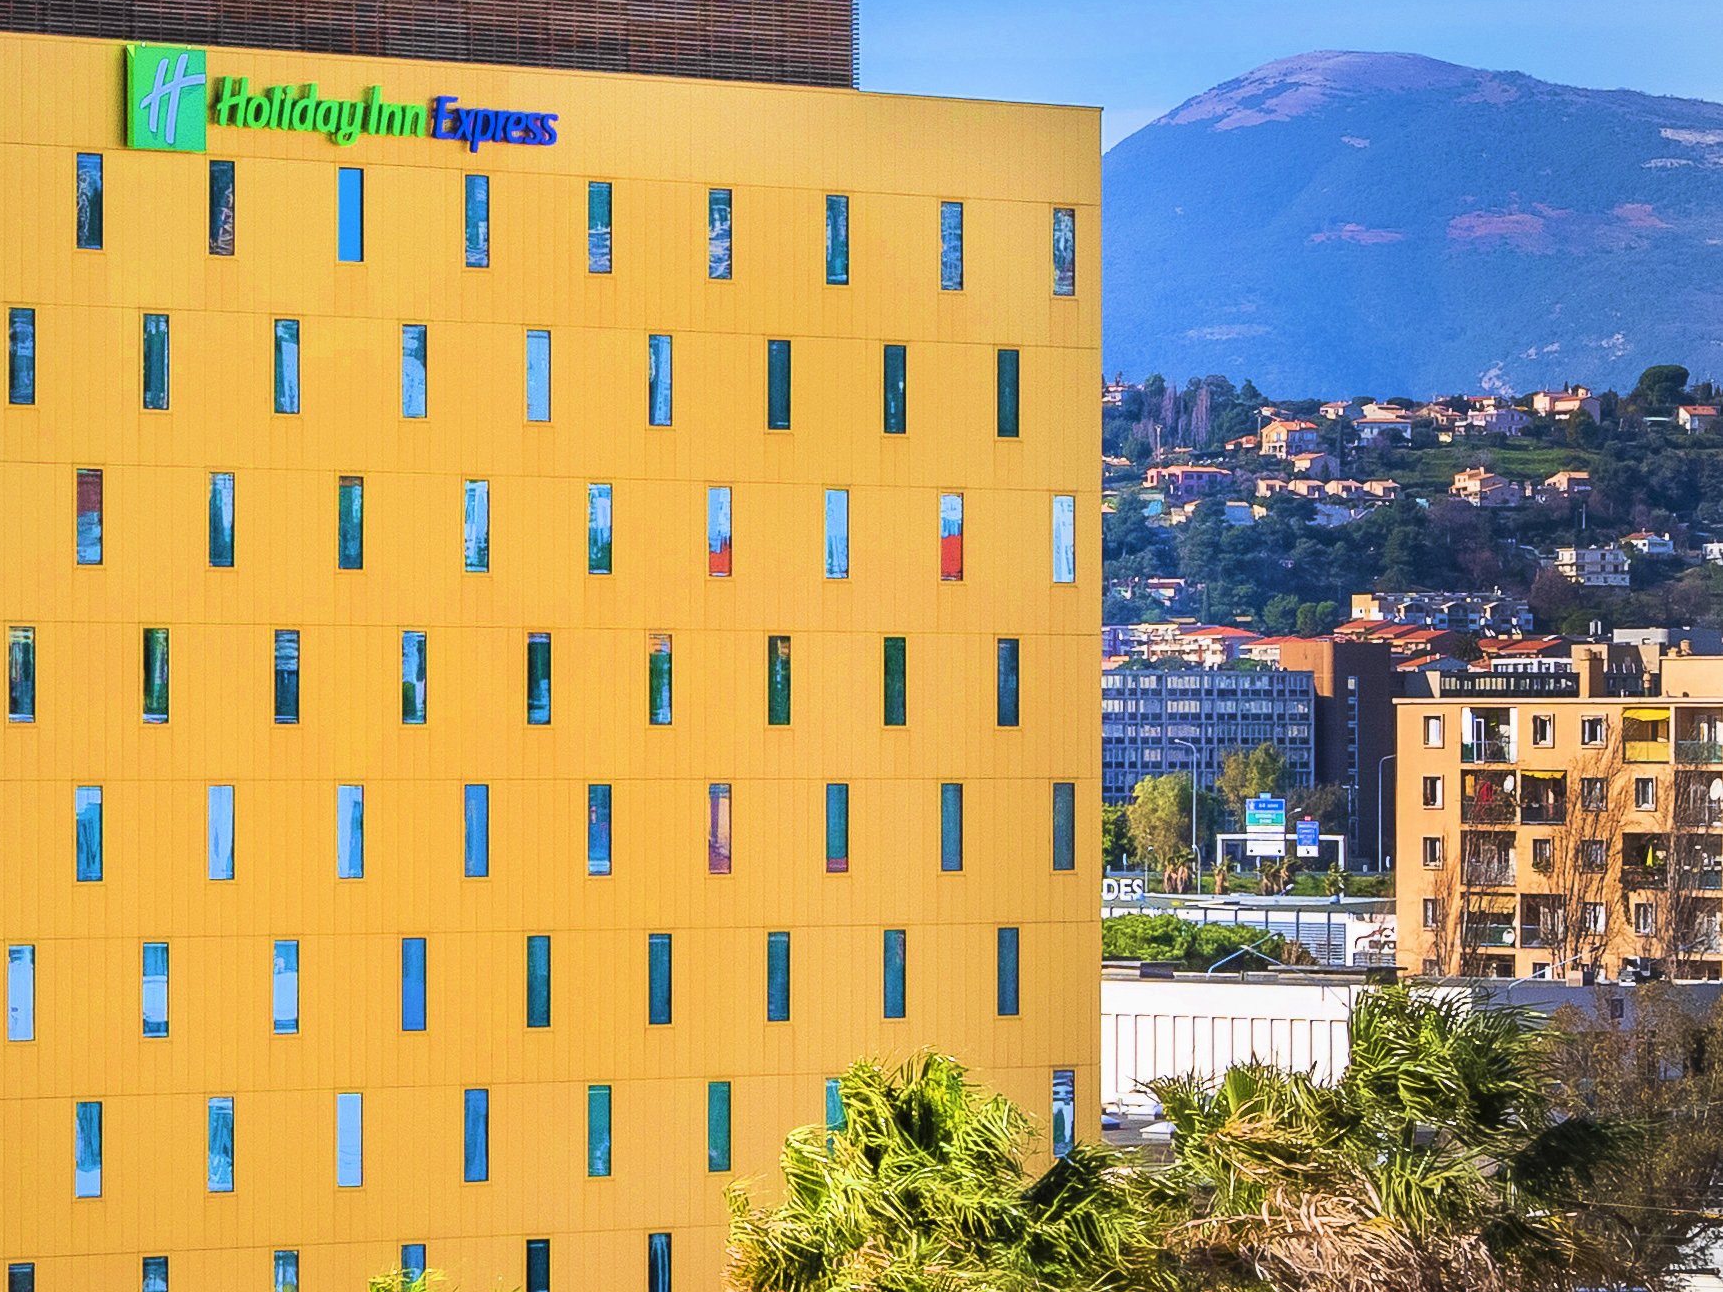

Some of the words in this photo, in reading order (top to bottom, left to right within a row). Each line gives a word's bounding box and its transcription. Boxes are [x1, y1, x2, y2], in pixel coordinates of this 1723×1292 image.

[216, 75, 364, 147] Holiday
[365, 84, 426, 138] Inn
[432, 95, 560, 154] Express
